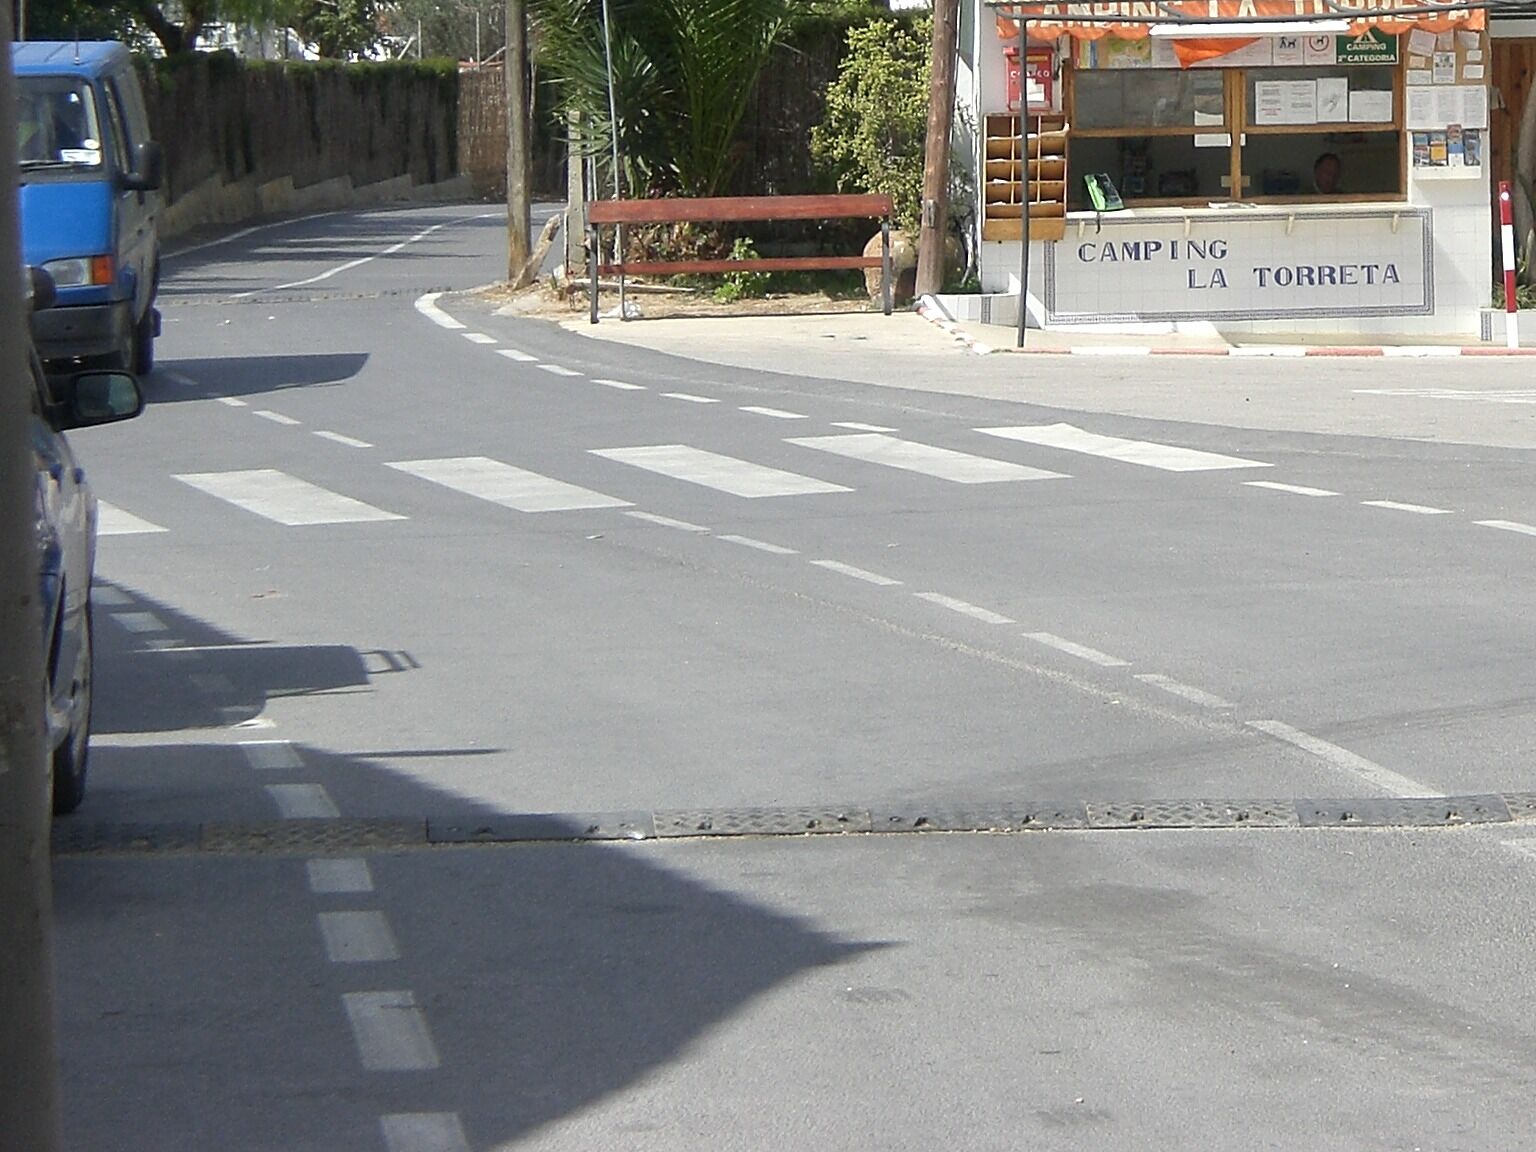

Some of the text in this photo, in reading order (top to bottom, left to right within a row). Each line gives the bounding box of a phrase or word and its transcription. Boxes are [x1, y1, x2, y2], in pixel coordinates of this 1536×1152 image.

[1346, 43, 1387, 51] CAMPING
[1077, 239, 1229, 262] CAMPING
[1187, 263, 1401, 289] LA TORRETA
